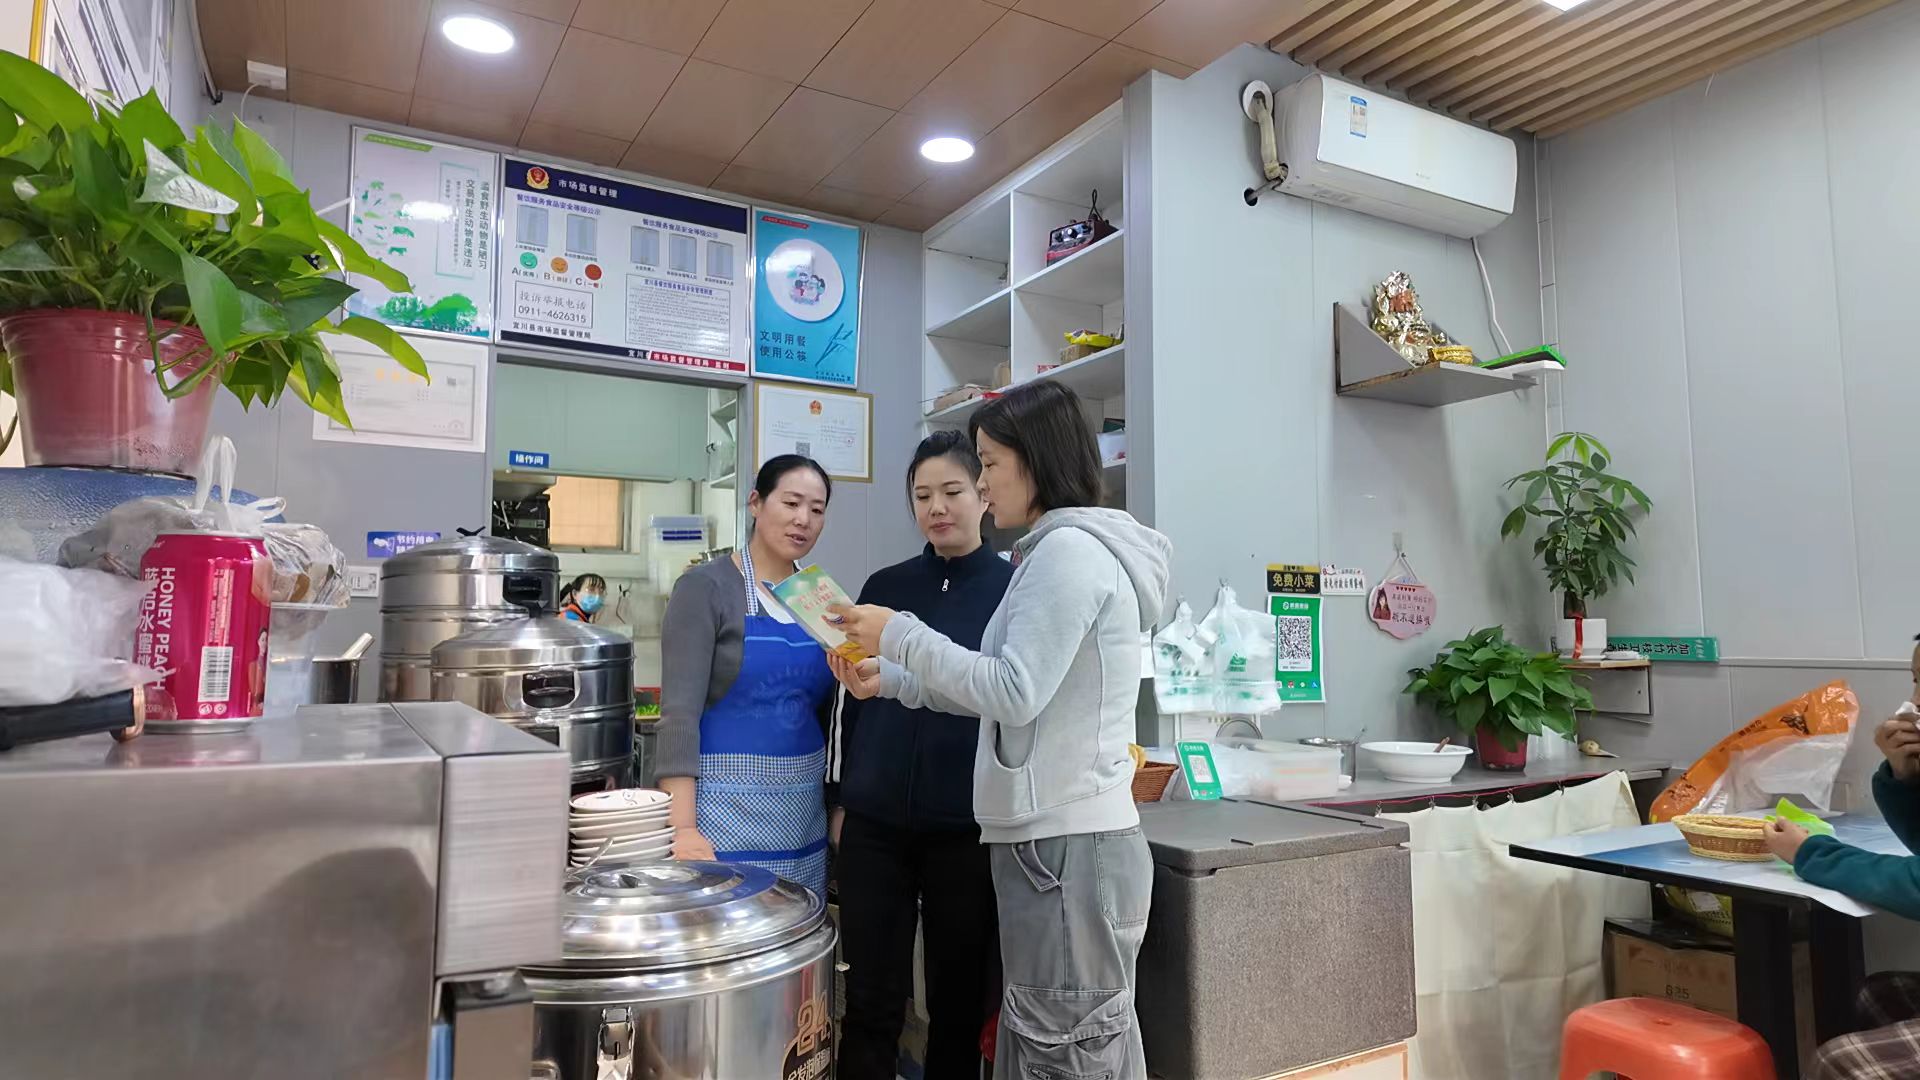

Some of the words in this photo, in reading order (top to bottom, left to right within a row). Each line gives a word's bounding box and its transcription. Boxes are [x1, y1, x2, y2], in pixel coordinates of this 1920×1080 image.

[558, 179, 618, 198] 市场监督管理
[519, 290, 586, 310] 投诉举报电话
[518, 305, 587, 323] 0911-4626315
[759, 329, 806, 347] 文明用餐
[759, 345, 807, 362] 使用公筷
[515, 453, 544, 465] 操作间
[1272, 572, 1315, 588] 免费小菜
[157, 567, 176, 629] HONEY
